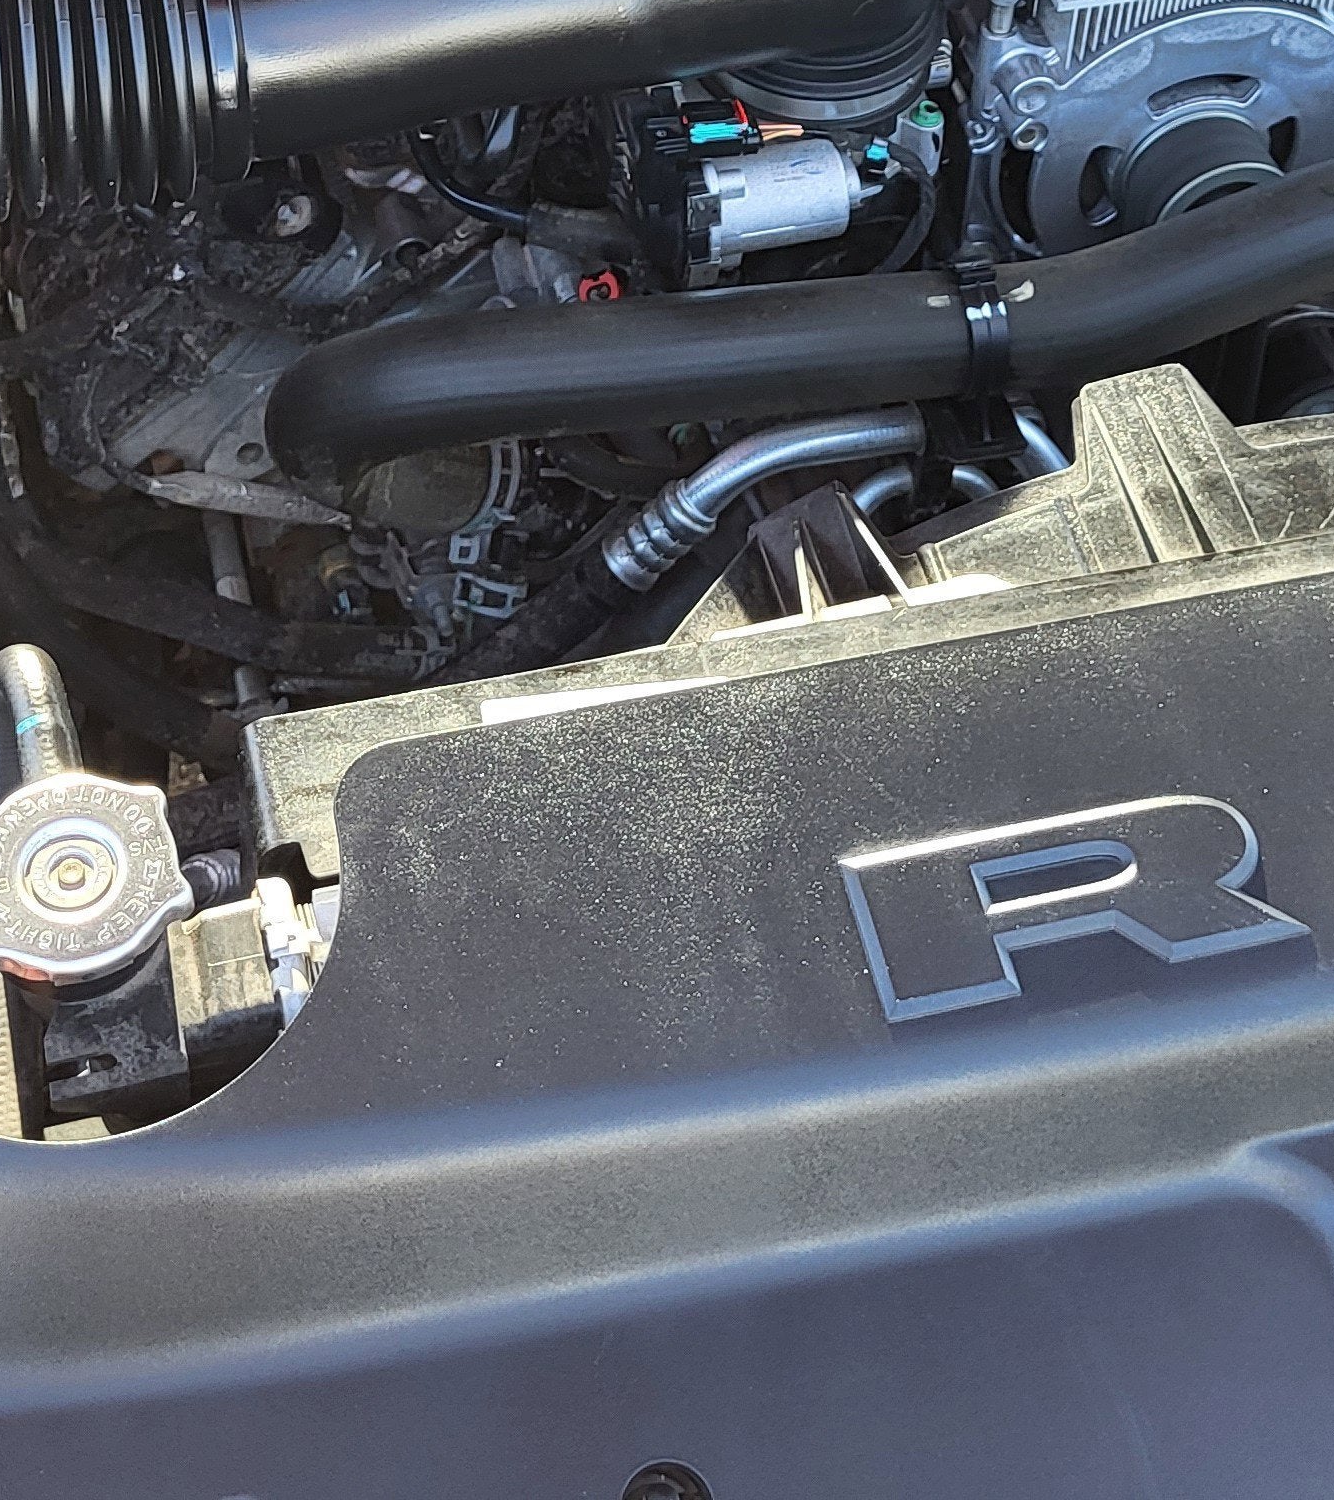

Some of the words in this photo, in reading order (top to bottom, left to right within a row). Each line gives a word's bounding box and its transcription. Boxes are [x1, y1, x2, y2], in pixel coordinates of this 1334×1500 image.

[3, 787, 69, 828] OPEN
[73, 785, 128, 811] NOT
[128, 834, 169, 857] TVS
[97, 883, 156, 943] KEEP
[3, 918, 82, 952] TIGHT
